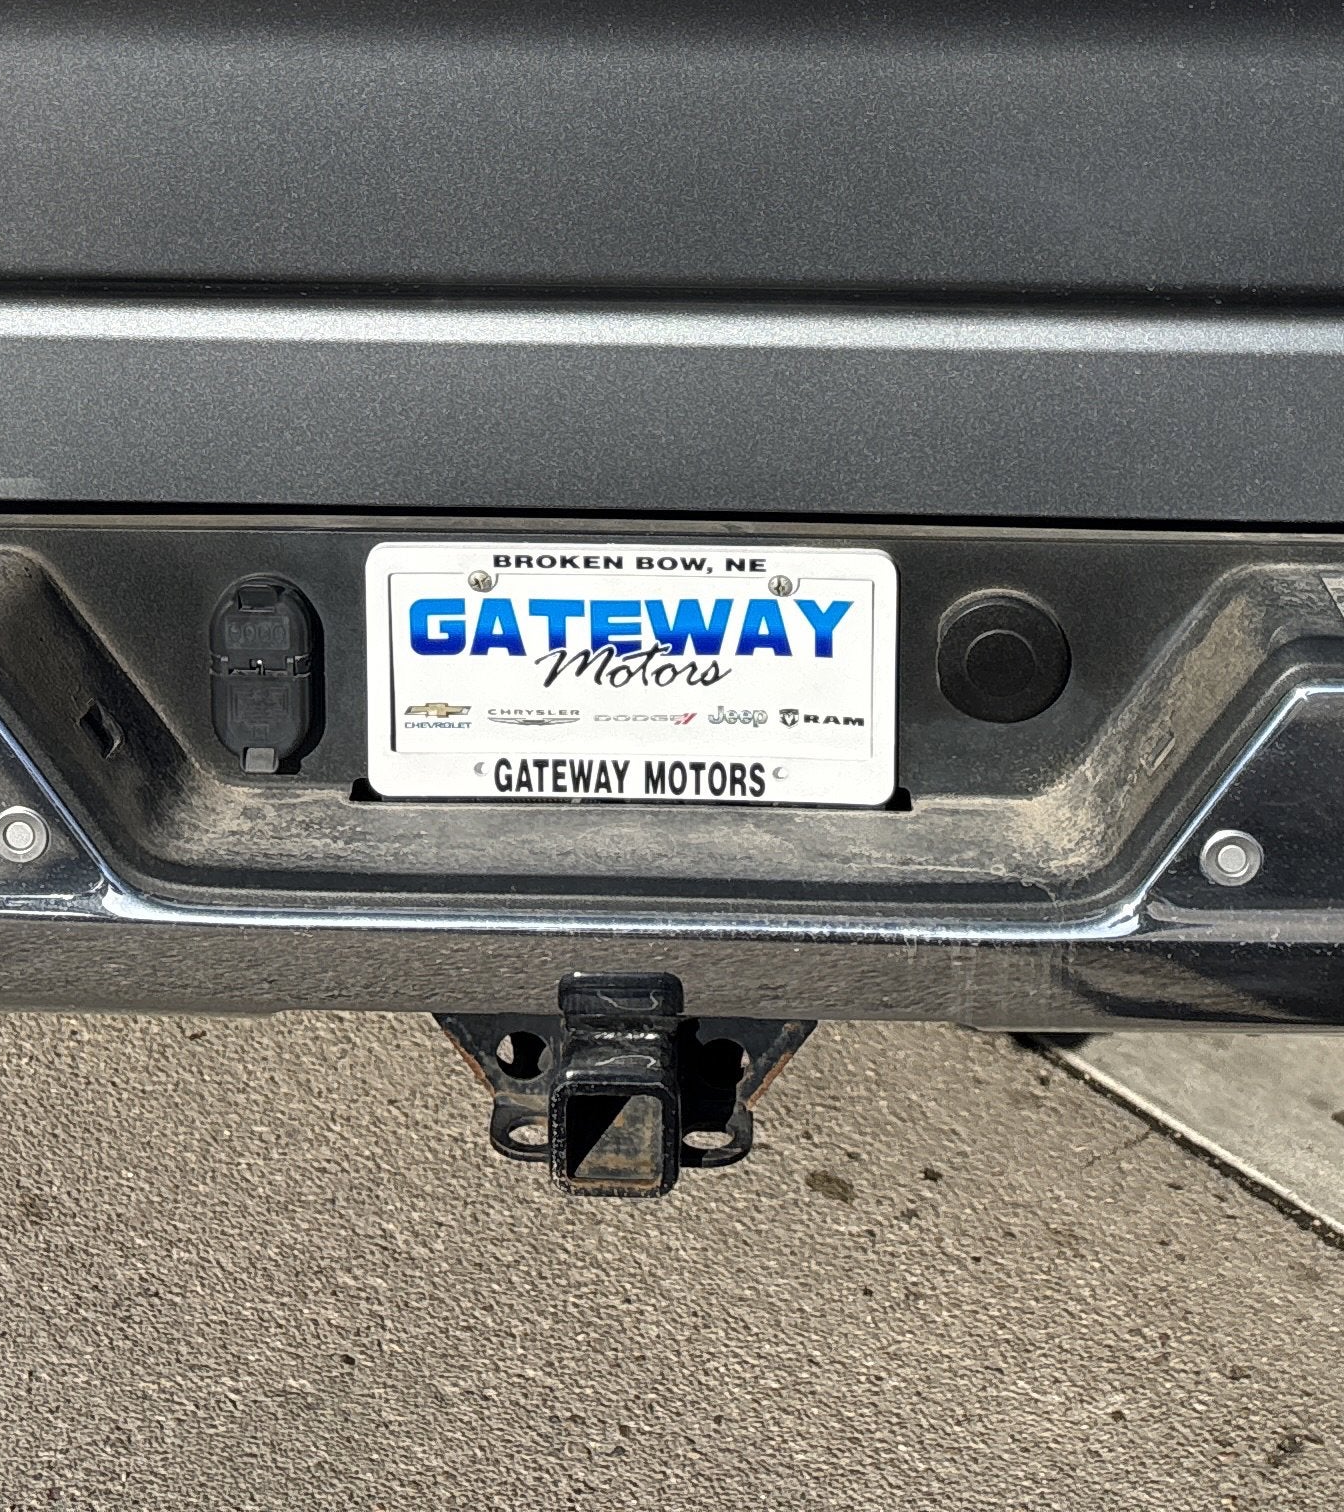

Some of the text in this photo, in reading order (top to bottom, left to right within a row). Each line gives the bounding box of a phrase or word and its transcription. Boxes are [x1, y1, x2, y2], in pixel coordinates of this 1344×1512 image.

[493, 554, 767, 575] BROKEN BOW, NE
[409, 597, 855, 659] GATEWAY
[534, 644, 733, 688] Motors
[404, 705, 865, 729] CHEVROLET CHRYSLER DODGE Jeep RAM
[493, 758, 766, 797] GATEWAY MOTORS
